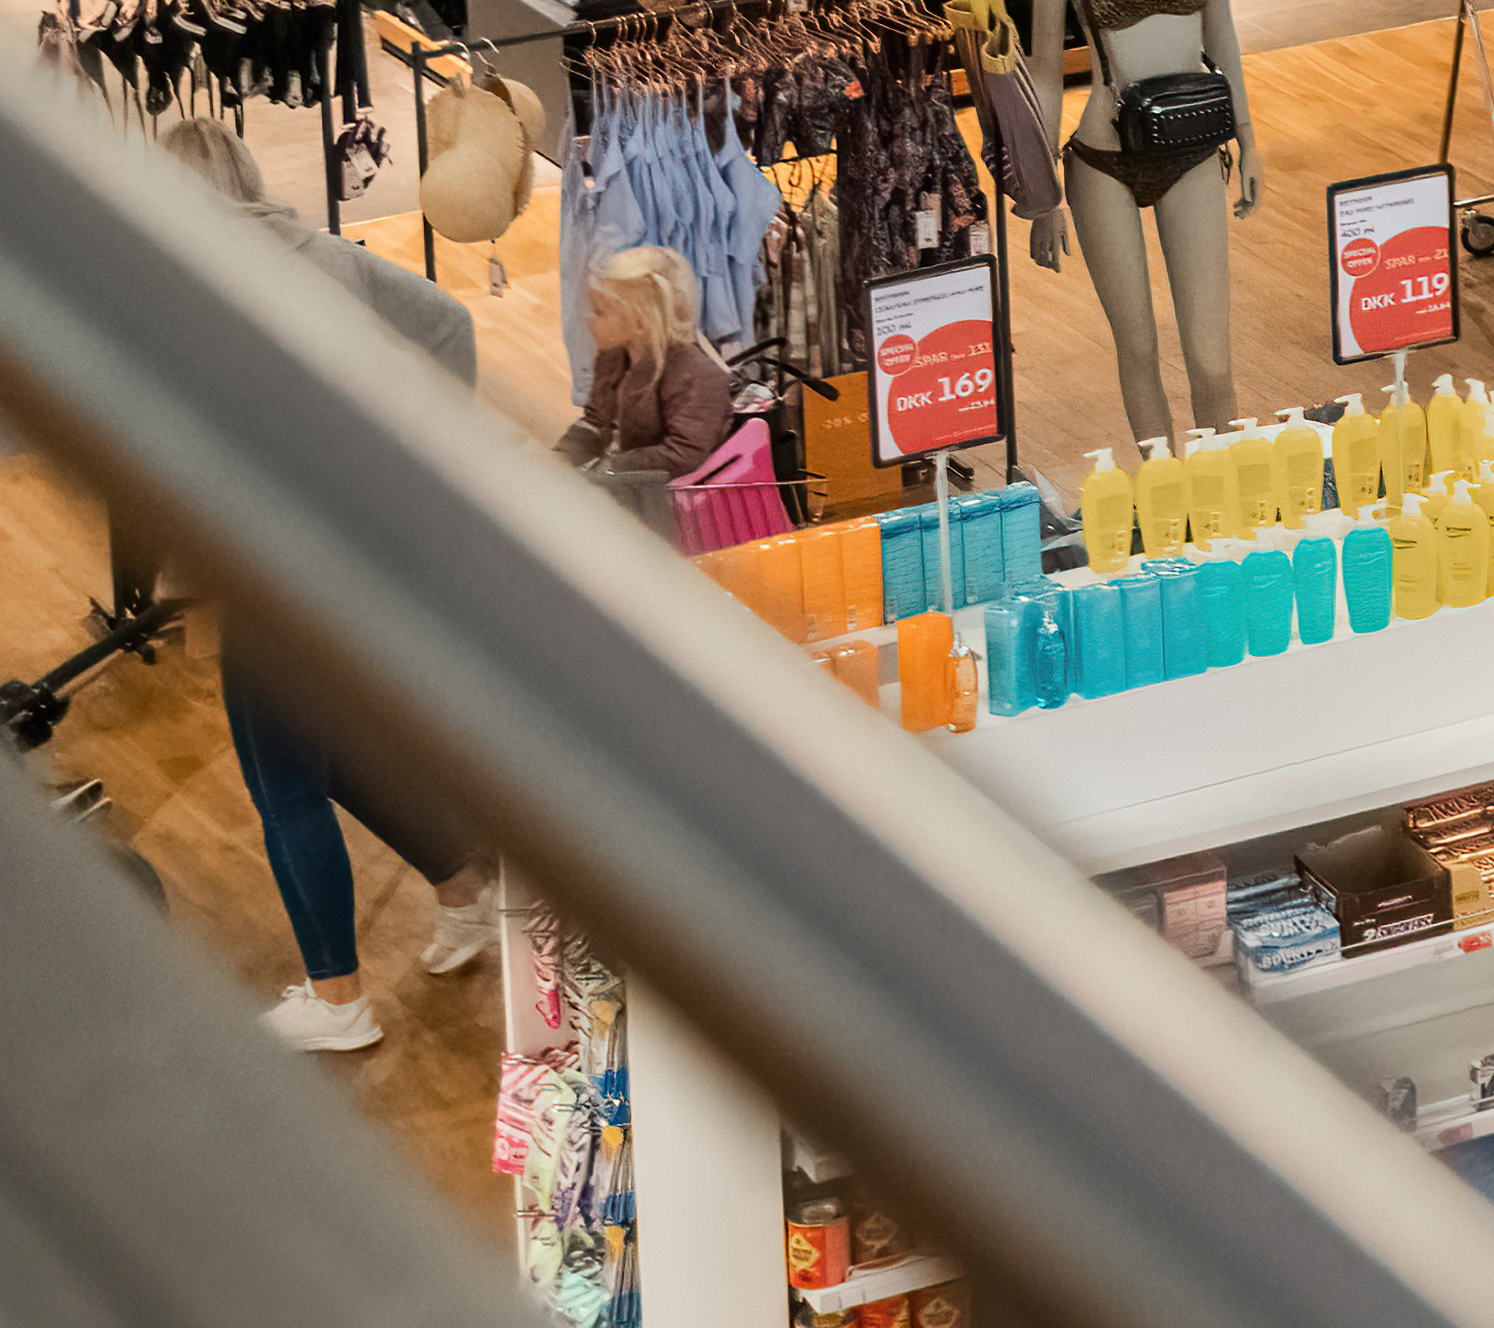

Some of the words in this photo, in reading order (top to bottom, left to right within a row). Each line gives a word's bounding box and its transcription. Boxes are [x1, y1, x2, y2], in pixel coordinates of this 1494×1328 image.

[1361, 292, 1396, 311] DKK
[1400, 271, 1449, 304] 119
[896, 390, 932, 412] DKK
[937, 368, 993, 402] 169
